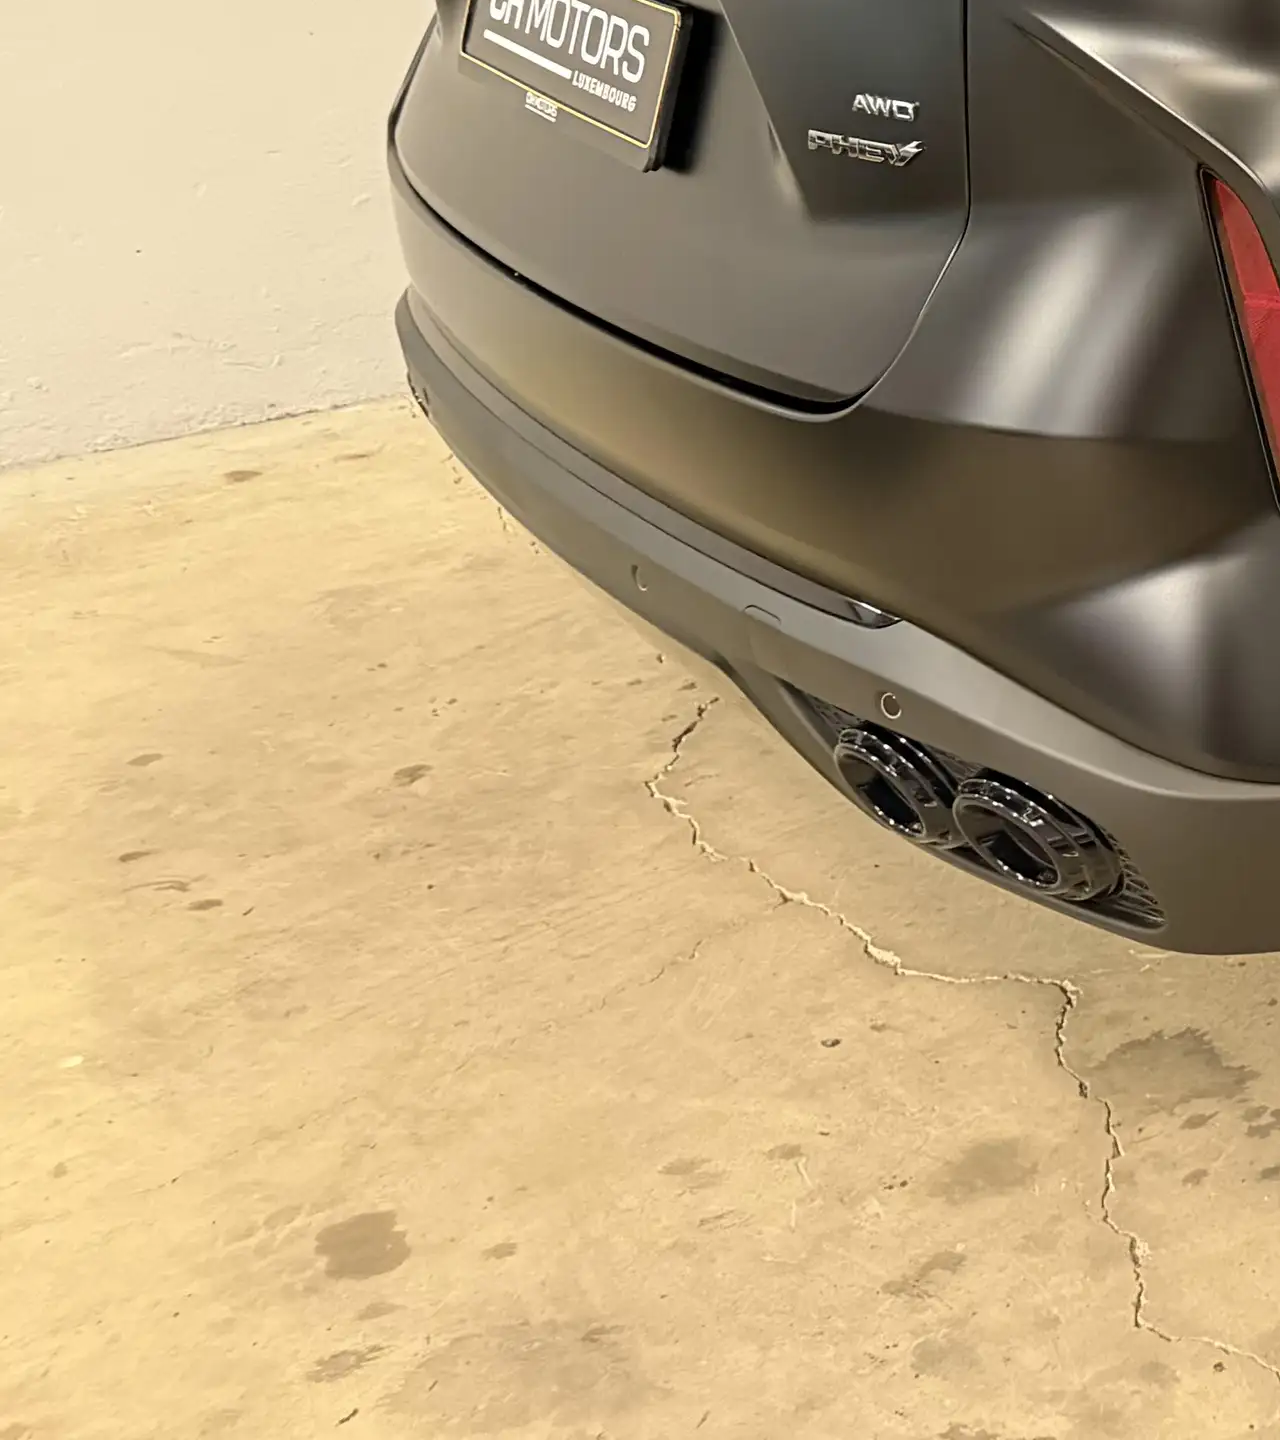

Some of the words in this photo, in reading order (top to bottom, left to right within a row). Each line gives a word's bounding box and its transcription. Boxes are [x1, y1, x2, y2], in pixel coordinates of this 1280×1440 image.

[571, 70, 638, 112] LUXEMBOURG
[851, 93, 917, 121] AWD
[807, 129, 923, 166] PHEV
